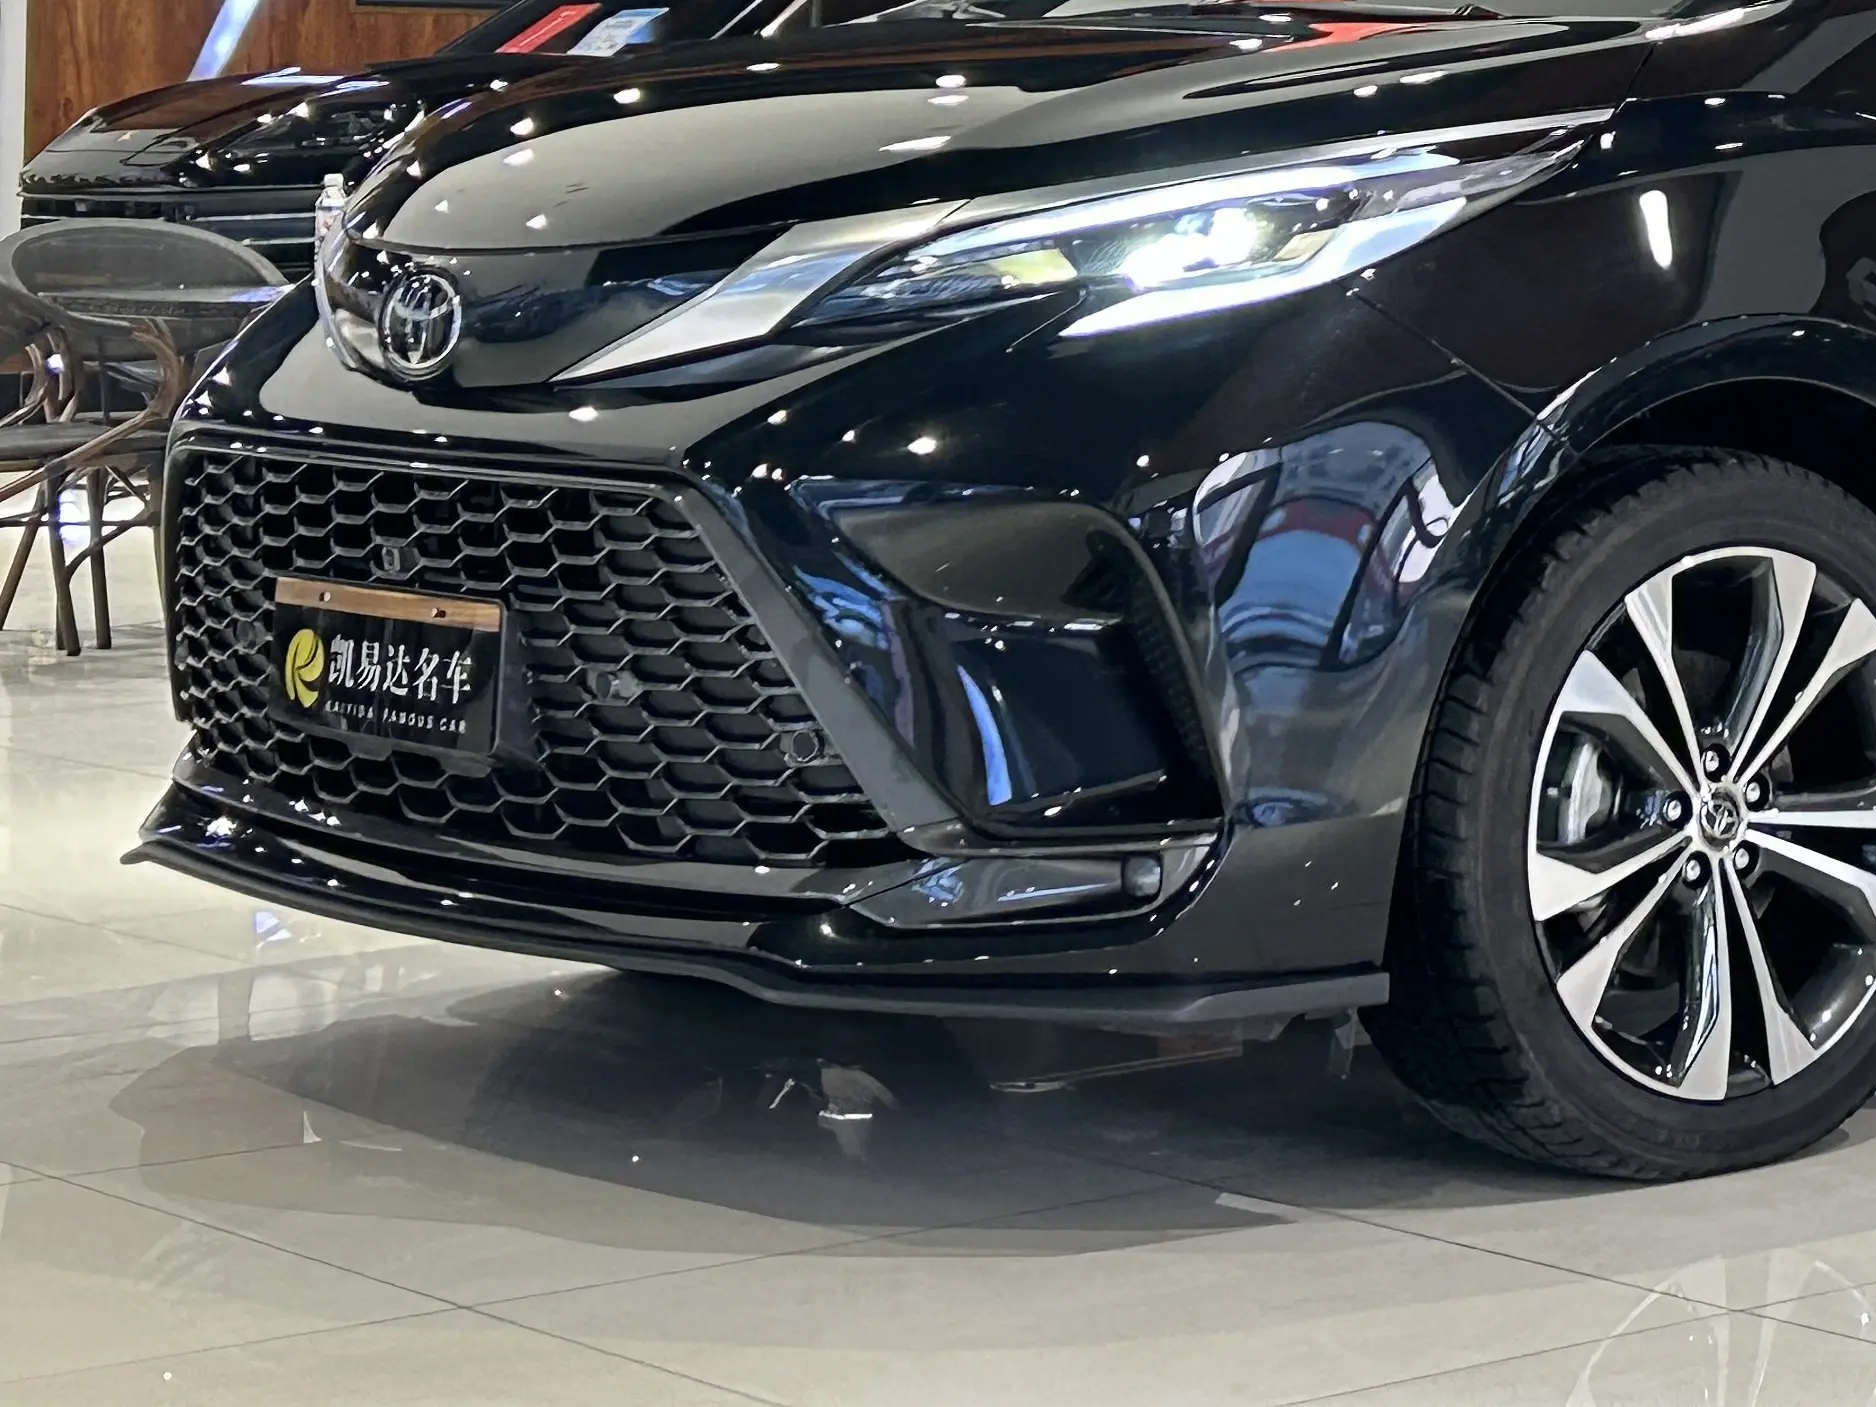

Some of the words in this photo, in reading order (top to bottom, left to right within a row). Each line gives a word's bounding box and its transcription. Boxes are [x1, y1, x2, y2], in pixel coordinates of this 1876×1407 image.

[328, 633, 474, 705] 凯易达名车
[382, 707, 435, 729] FAMOUS
[439, 717, 467, 734] CAR
